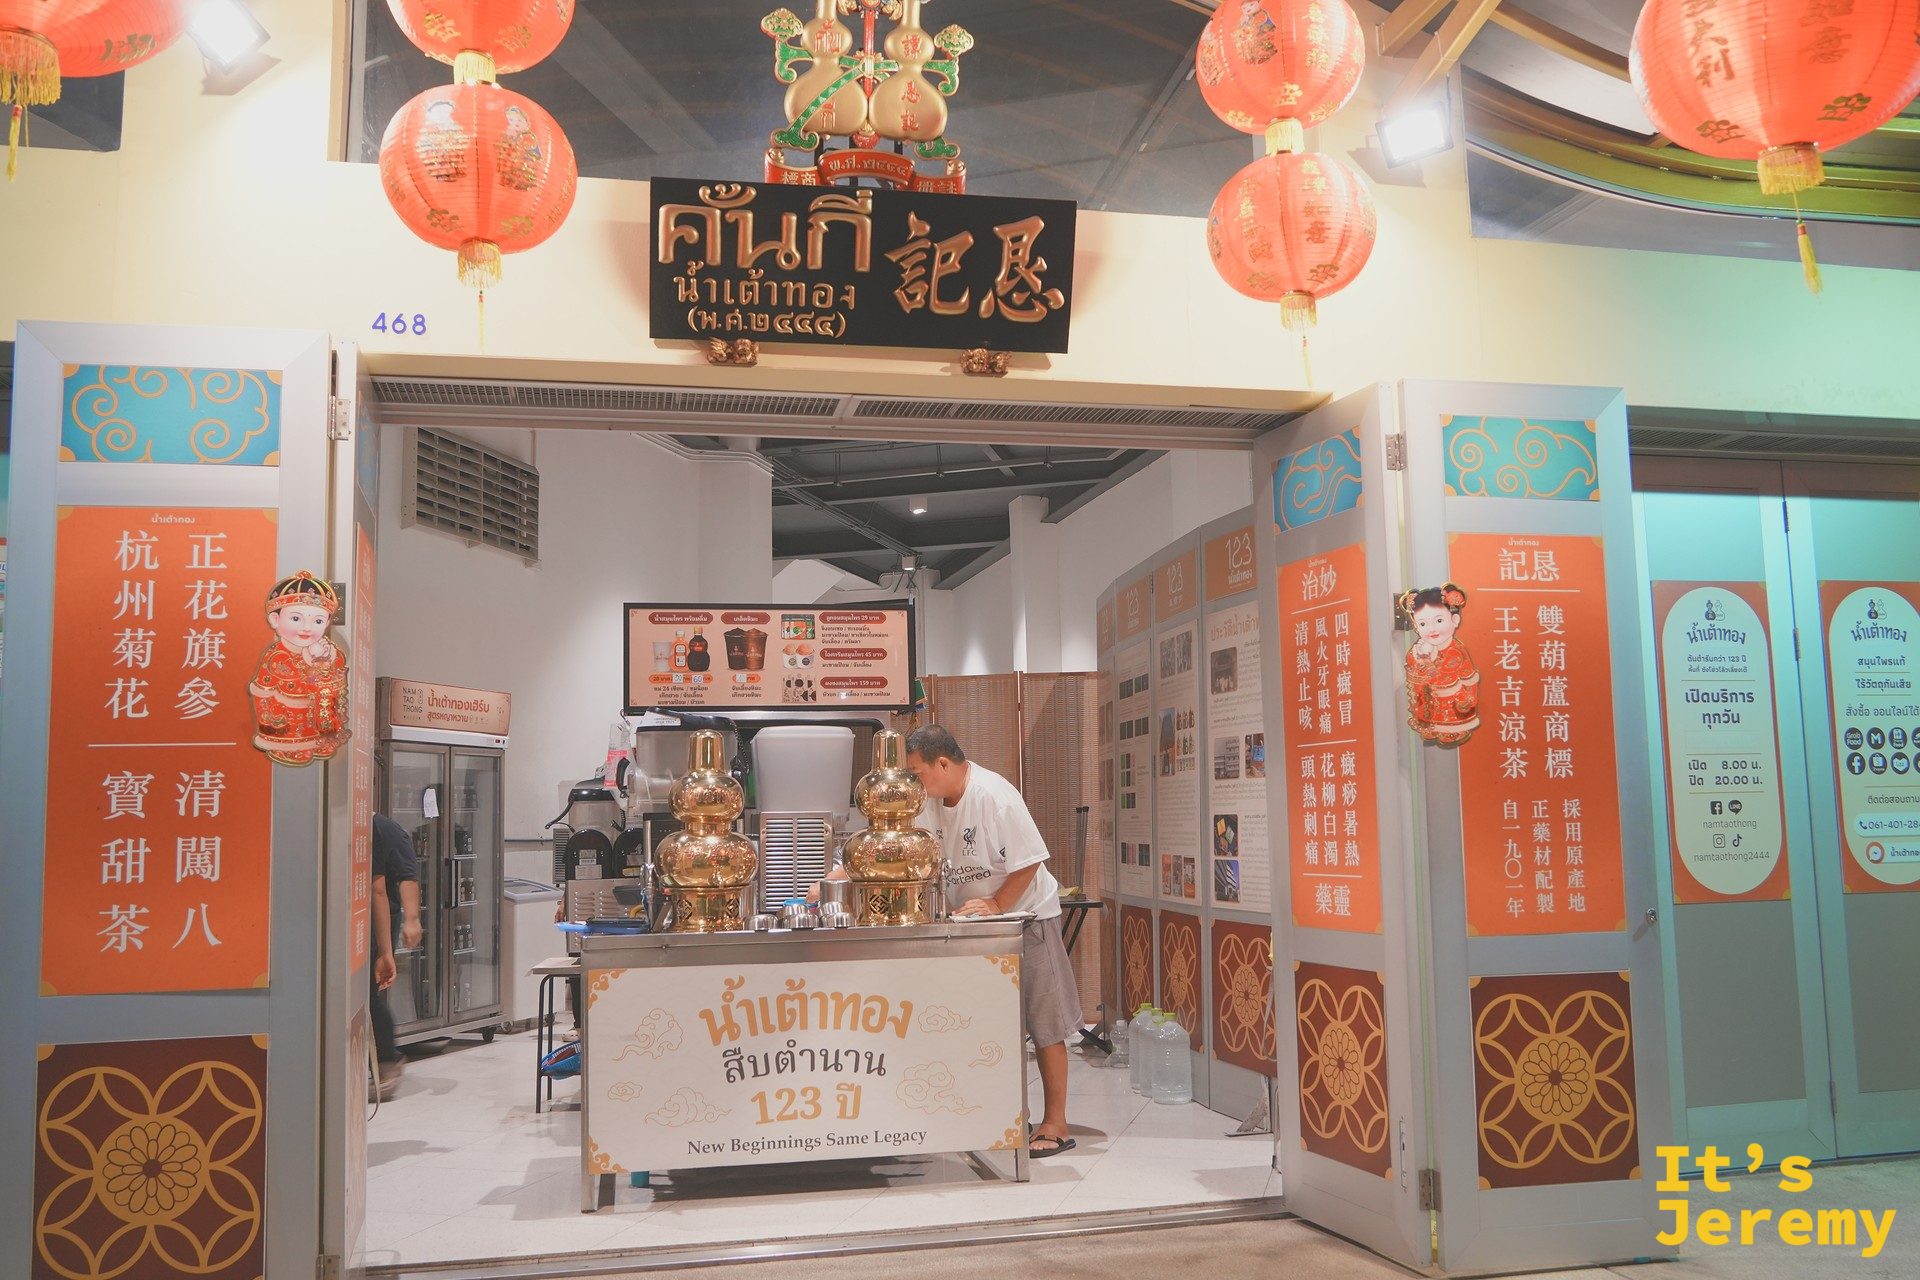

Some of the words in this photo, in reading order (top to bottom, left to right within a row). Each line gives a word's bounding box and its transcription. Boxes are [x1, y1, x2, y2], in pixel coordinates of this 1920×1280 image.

[673, 261, 856, 311] น้ำเต้าทอง
[371, 312, 428, 336] 468
[687, 306, 847, 338] (พ.ศ.๒๔๔๔)
[1225, 532, 1253, 569] 123
[1166, 562, 1183, 594] 123
[104, 529, 159, 720] 杭州菊花
[174, 532, 228, 720] 正花旗參
[1686, 622, 1747, 645] น้ำเต้าทอง
[1850, 621, 1907, 642] น้ำเต้าทอง
[1728, 655, 1740, 663] 123
[1857, 655, 1906, 669] สมุนไพรแท้
[1295, 621, 1313, 730] 清熱止咳
[1315, 616, 1332, 735] 風火牙眼痛
[1856, 678, 1912, 692] ไร้วัตถุกันเสีย
[402, 687, 417, 695] NAM
[403, 696, 415, 704] TAO
[1493, 605, 1528, 779] 王老吉涼茶
[1536, 604, 1574, 779] 雙葫蘆商標
[1685, 688, 1755, 703] เปิดบริการ
[402, 704, 423, 713] THONG
[1702, 708, 1740, 729] ทุกวัน
[1688, 759, 1707, 771] เปิด
[1721, 760, 1748, 770] 8.00
[1751, 760, 1762, 770] น.
[1688, 775, 1704, 786] ปิด
[1714, 775, 1749, 785] 20.00
[1752, 775, 1763, 785] น.
[1301, 754, 1318, 865] 頭熱刺痛
[1319, 752, 1338, 866] 花柳白濁
[1702, 819, 1757, 829] namtaothong
[1868, 820, 1920, 830] 061-401-28
[172, 769, 226, 949] 清闖八
[1531, 799, 1555, 913] 正藥材配製
[1562, 799, 1586, 912] 採用原產地
[1693, 851, 1770, 862] namtaothong2444
[1890, 847, 1920, 857] น้ำเต้าทอ
[699, 975, 914, 1047] น้ำเต้าทอง
[723, 1039, 887, 1084] สืบตำนาน
[750, 1085, 822, 1126] 123
[837, 1082, 862, 1120] ปี
[688, 1139, 725, 1155] New
[730, 1133, 822, 1153] Beginnings
[826, 1131, 869, 1147] Same
[874, 1128, 927, 1147] Legacy
